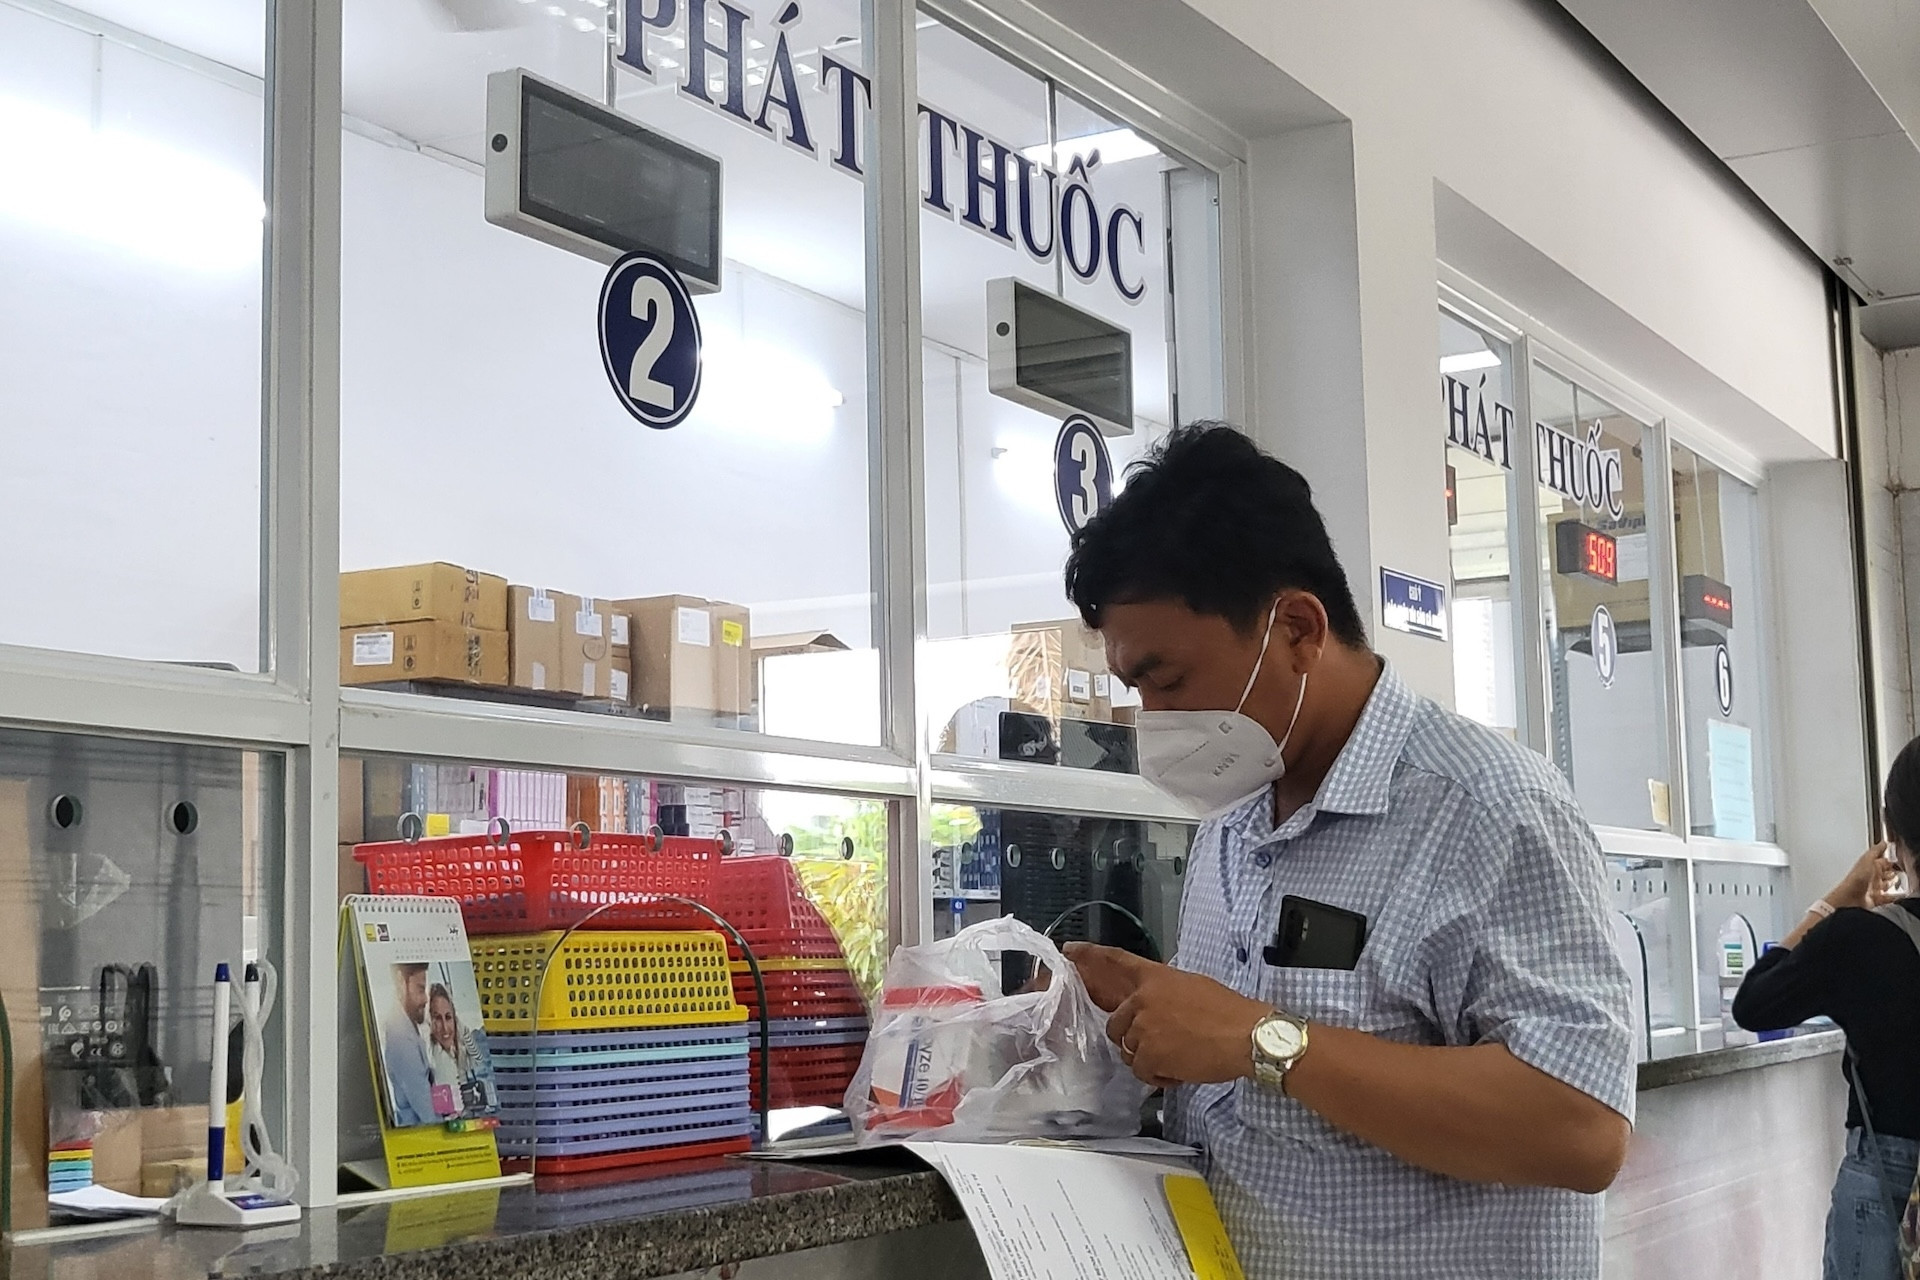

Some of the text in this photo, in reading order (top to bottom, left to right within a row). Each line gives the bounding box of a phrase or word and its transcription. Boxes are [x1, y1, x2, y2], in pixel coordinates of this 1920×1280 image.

[615, 0, 1147, 301] PHÁT THUỐC
[628, 274, 677, 412] 2
[1441, 372, 1515, 471] HÁT
[1069, 440, 1100, 528] 3
[1587, 533, 1615, 578] 509
[1596, 612, 1611, 679] 5
[1718, 650, 1730, 713] 6
